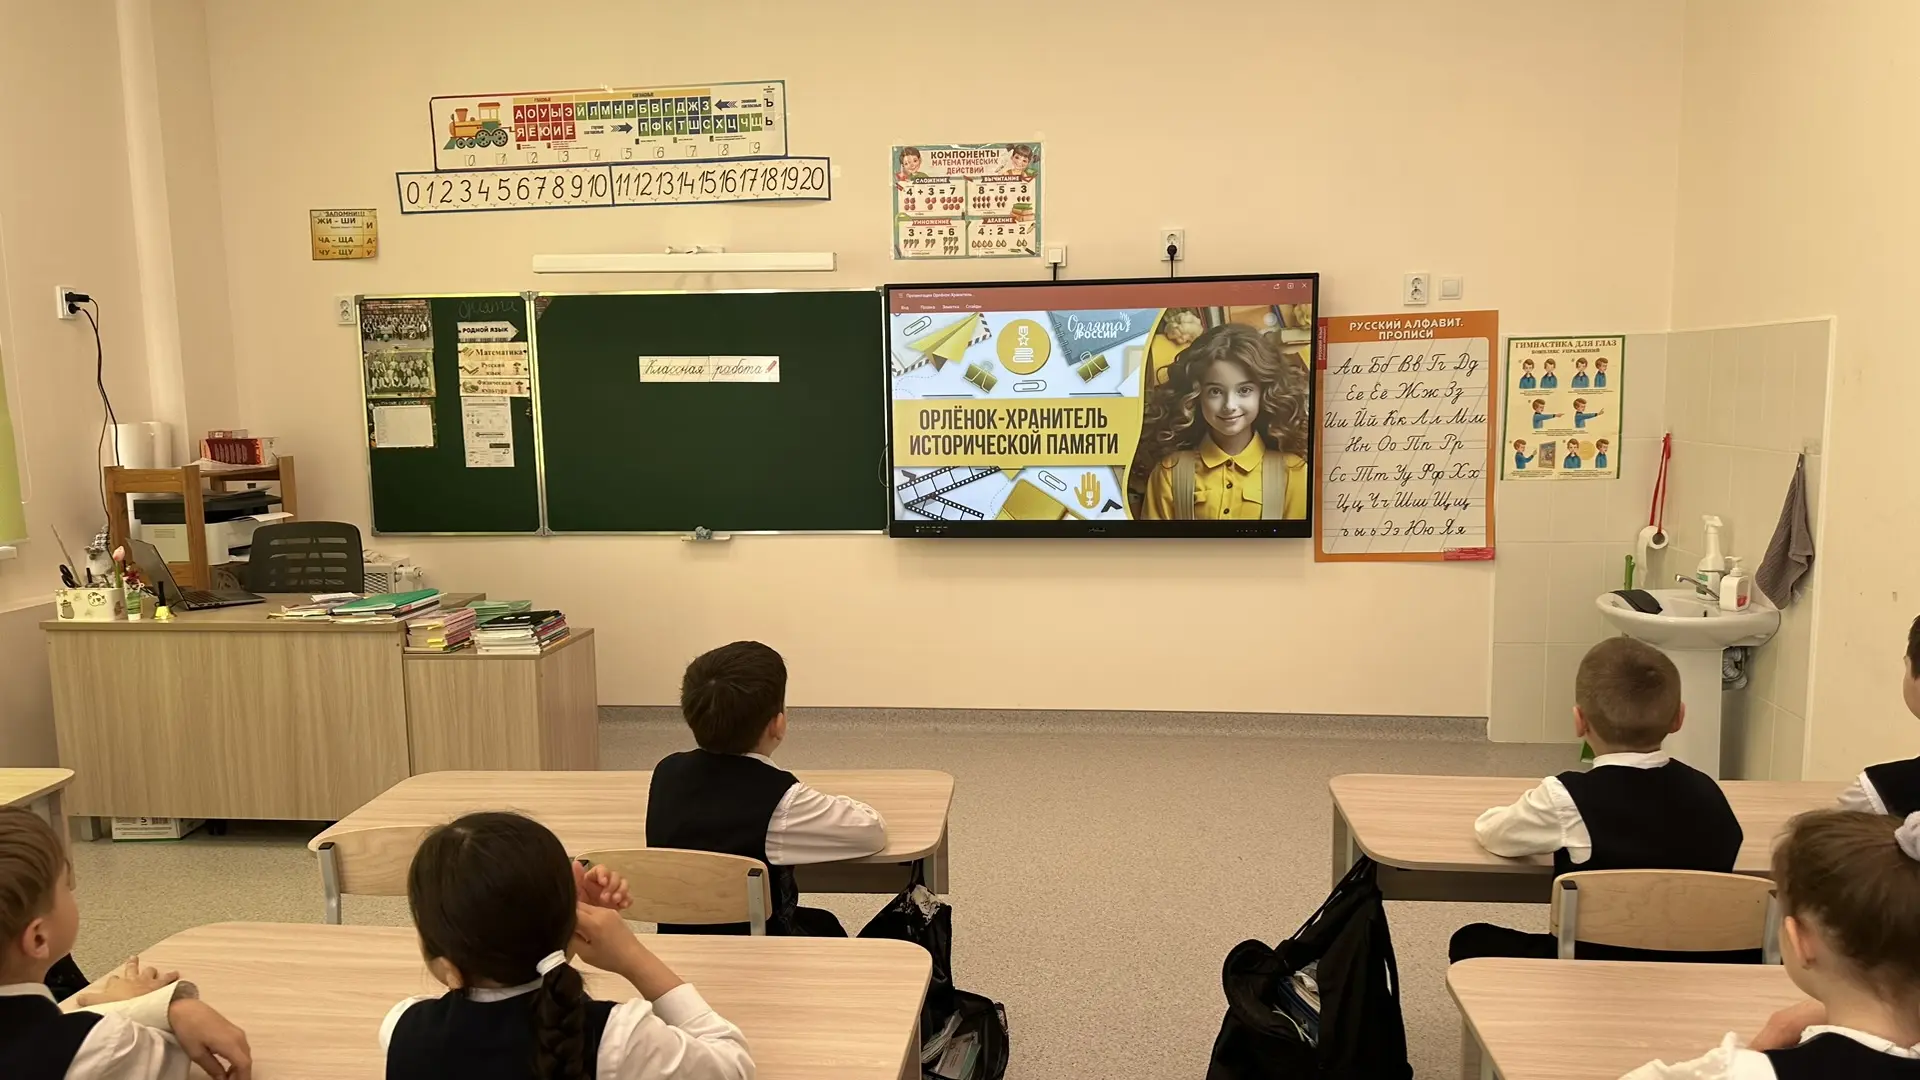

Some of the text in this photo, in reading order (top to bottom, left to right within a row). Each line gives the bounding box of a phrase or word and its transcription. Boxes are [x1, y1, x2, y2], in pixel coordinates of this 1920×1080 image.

[931, 150, 999, 159] КОМПОНЕНТЫ
[932, 158, 998, 166] МАТЕМАТИЧЕСКИХ
[946, 166, 984, 175] ДЕЙСТВИЙ
[407, 167, 824, 204] 0 1 2 3 4 5 6 7 8 9 10 11 12 13 14 15 16 17 18 19 20
[1067, 314, 1126, 340] Орлята
[1078, 330, 1117, 339] РОССИИ
[1350, 318, 1463, 331] РУССКИЙ АЛФАВИТ.
[1379, 330, 1433, 340] ПРОПИСИ
[644, 359, 763, 380] Классная работа
[1333, 353, 1478, 377] Аа Бб Вв Гг Дд
[1346, 381, 1464, 404] Ее Ёё Жж Зз
[919, 406, 1108, 431] ОРЛЁНОК-ХРАНИТЕЛЬ
[1324, 408, 1486, 428] Ии Йй Кк Лл Мм
[910, 430, 1118, 456] ИСТОРИЧЕСКОЙ ПАМЯТИ
[1345, 434, 1464, 455] Нн Оо Пп Рр
[1329, 463, 1480, 487] Сс Тт Уу Фф Хх
[1337, 491, 1471, 513] Цц Чч Шш Щщ
[1341, 528, 1349, 536] ъ
[1354, 528, 1366, 536] ы
[1381, 520, 1400, 536] Ээ
[1404, 520, 1434, 536] Юю
[1439, 519, 1466, 535] Яя
